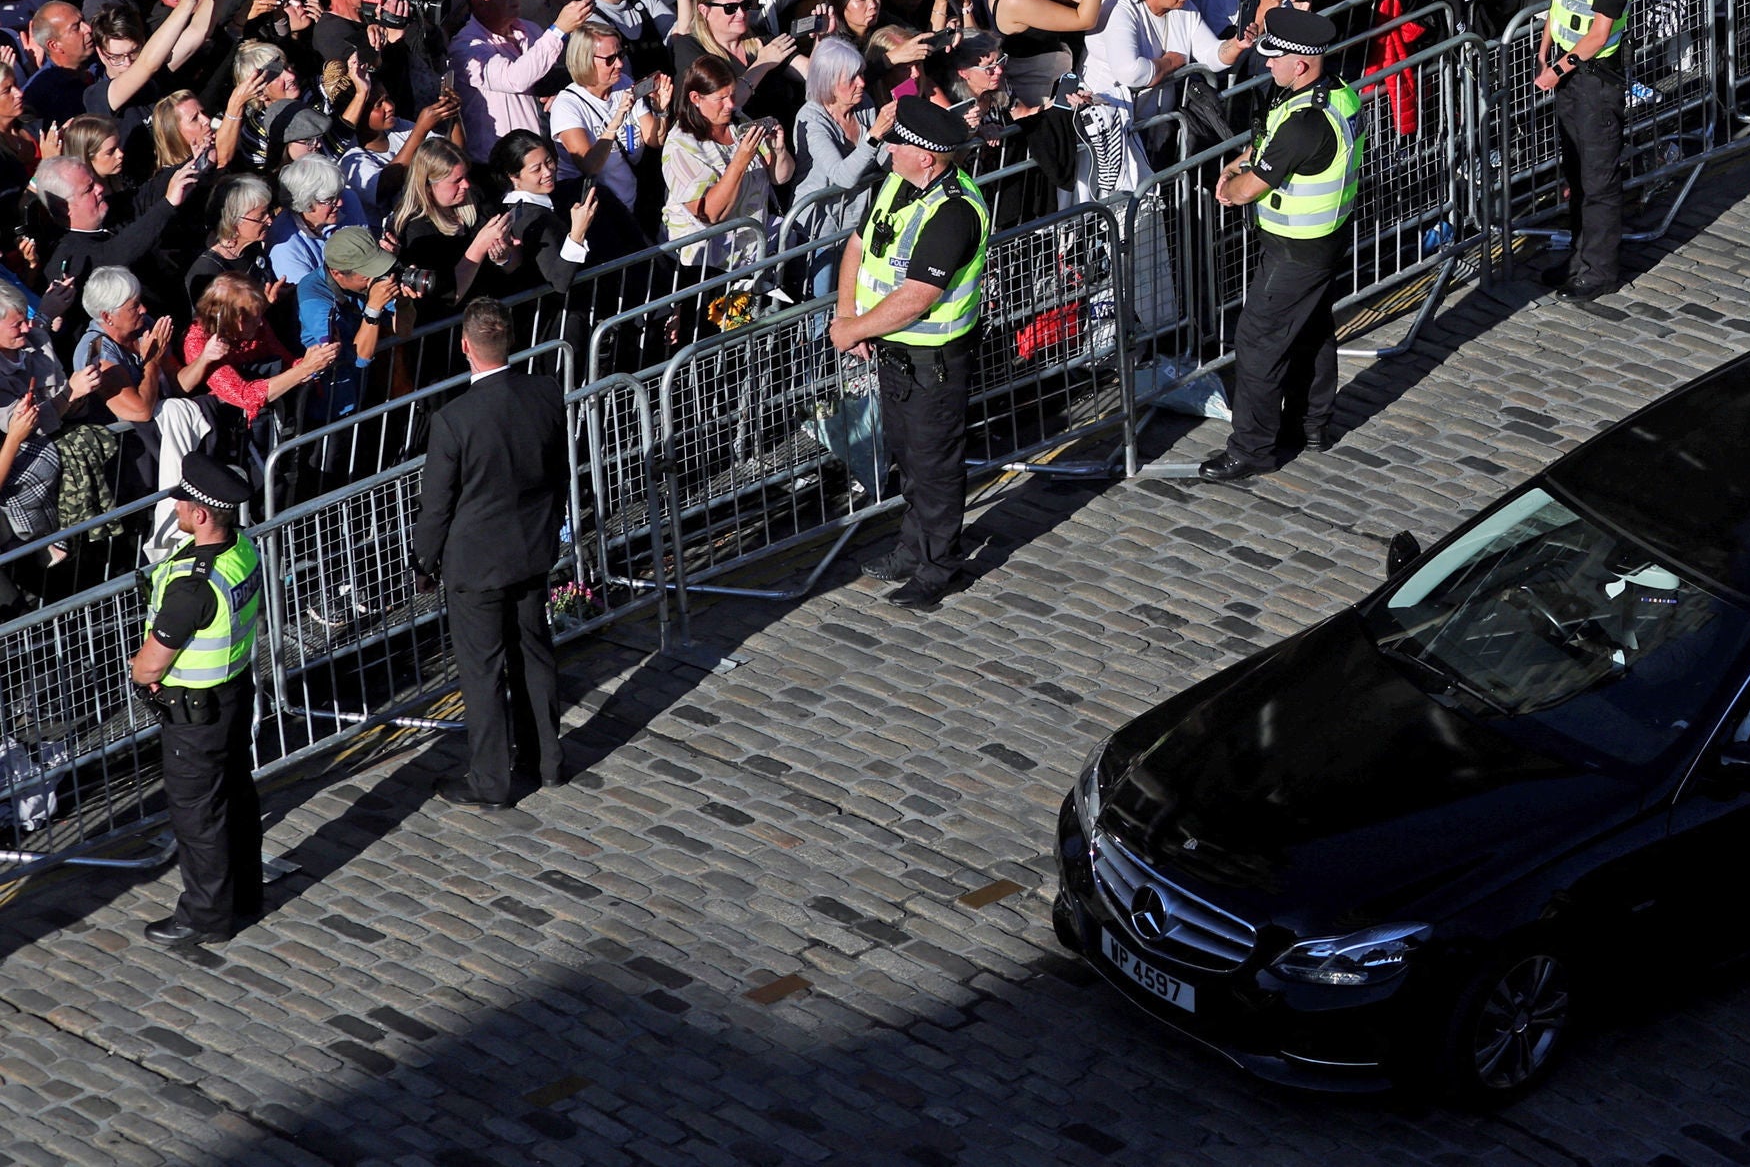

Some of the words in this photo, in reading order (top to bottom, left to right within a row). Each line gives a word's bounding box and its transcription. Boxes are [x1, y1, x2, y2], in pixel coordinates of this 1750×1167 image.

[890, 258, 909, 268] POLIC
[1111, 938, 1129, 968] WP
[1133, 960, 1182, 1002] 4597
